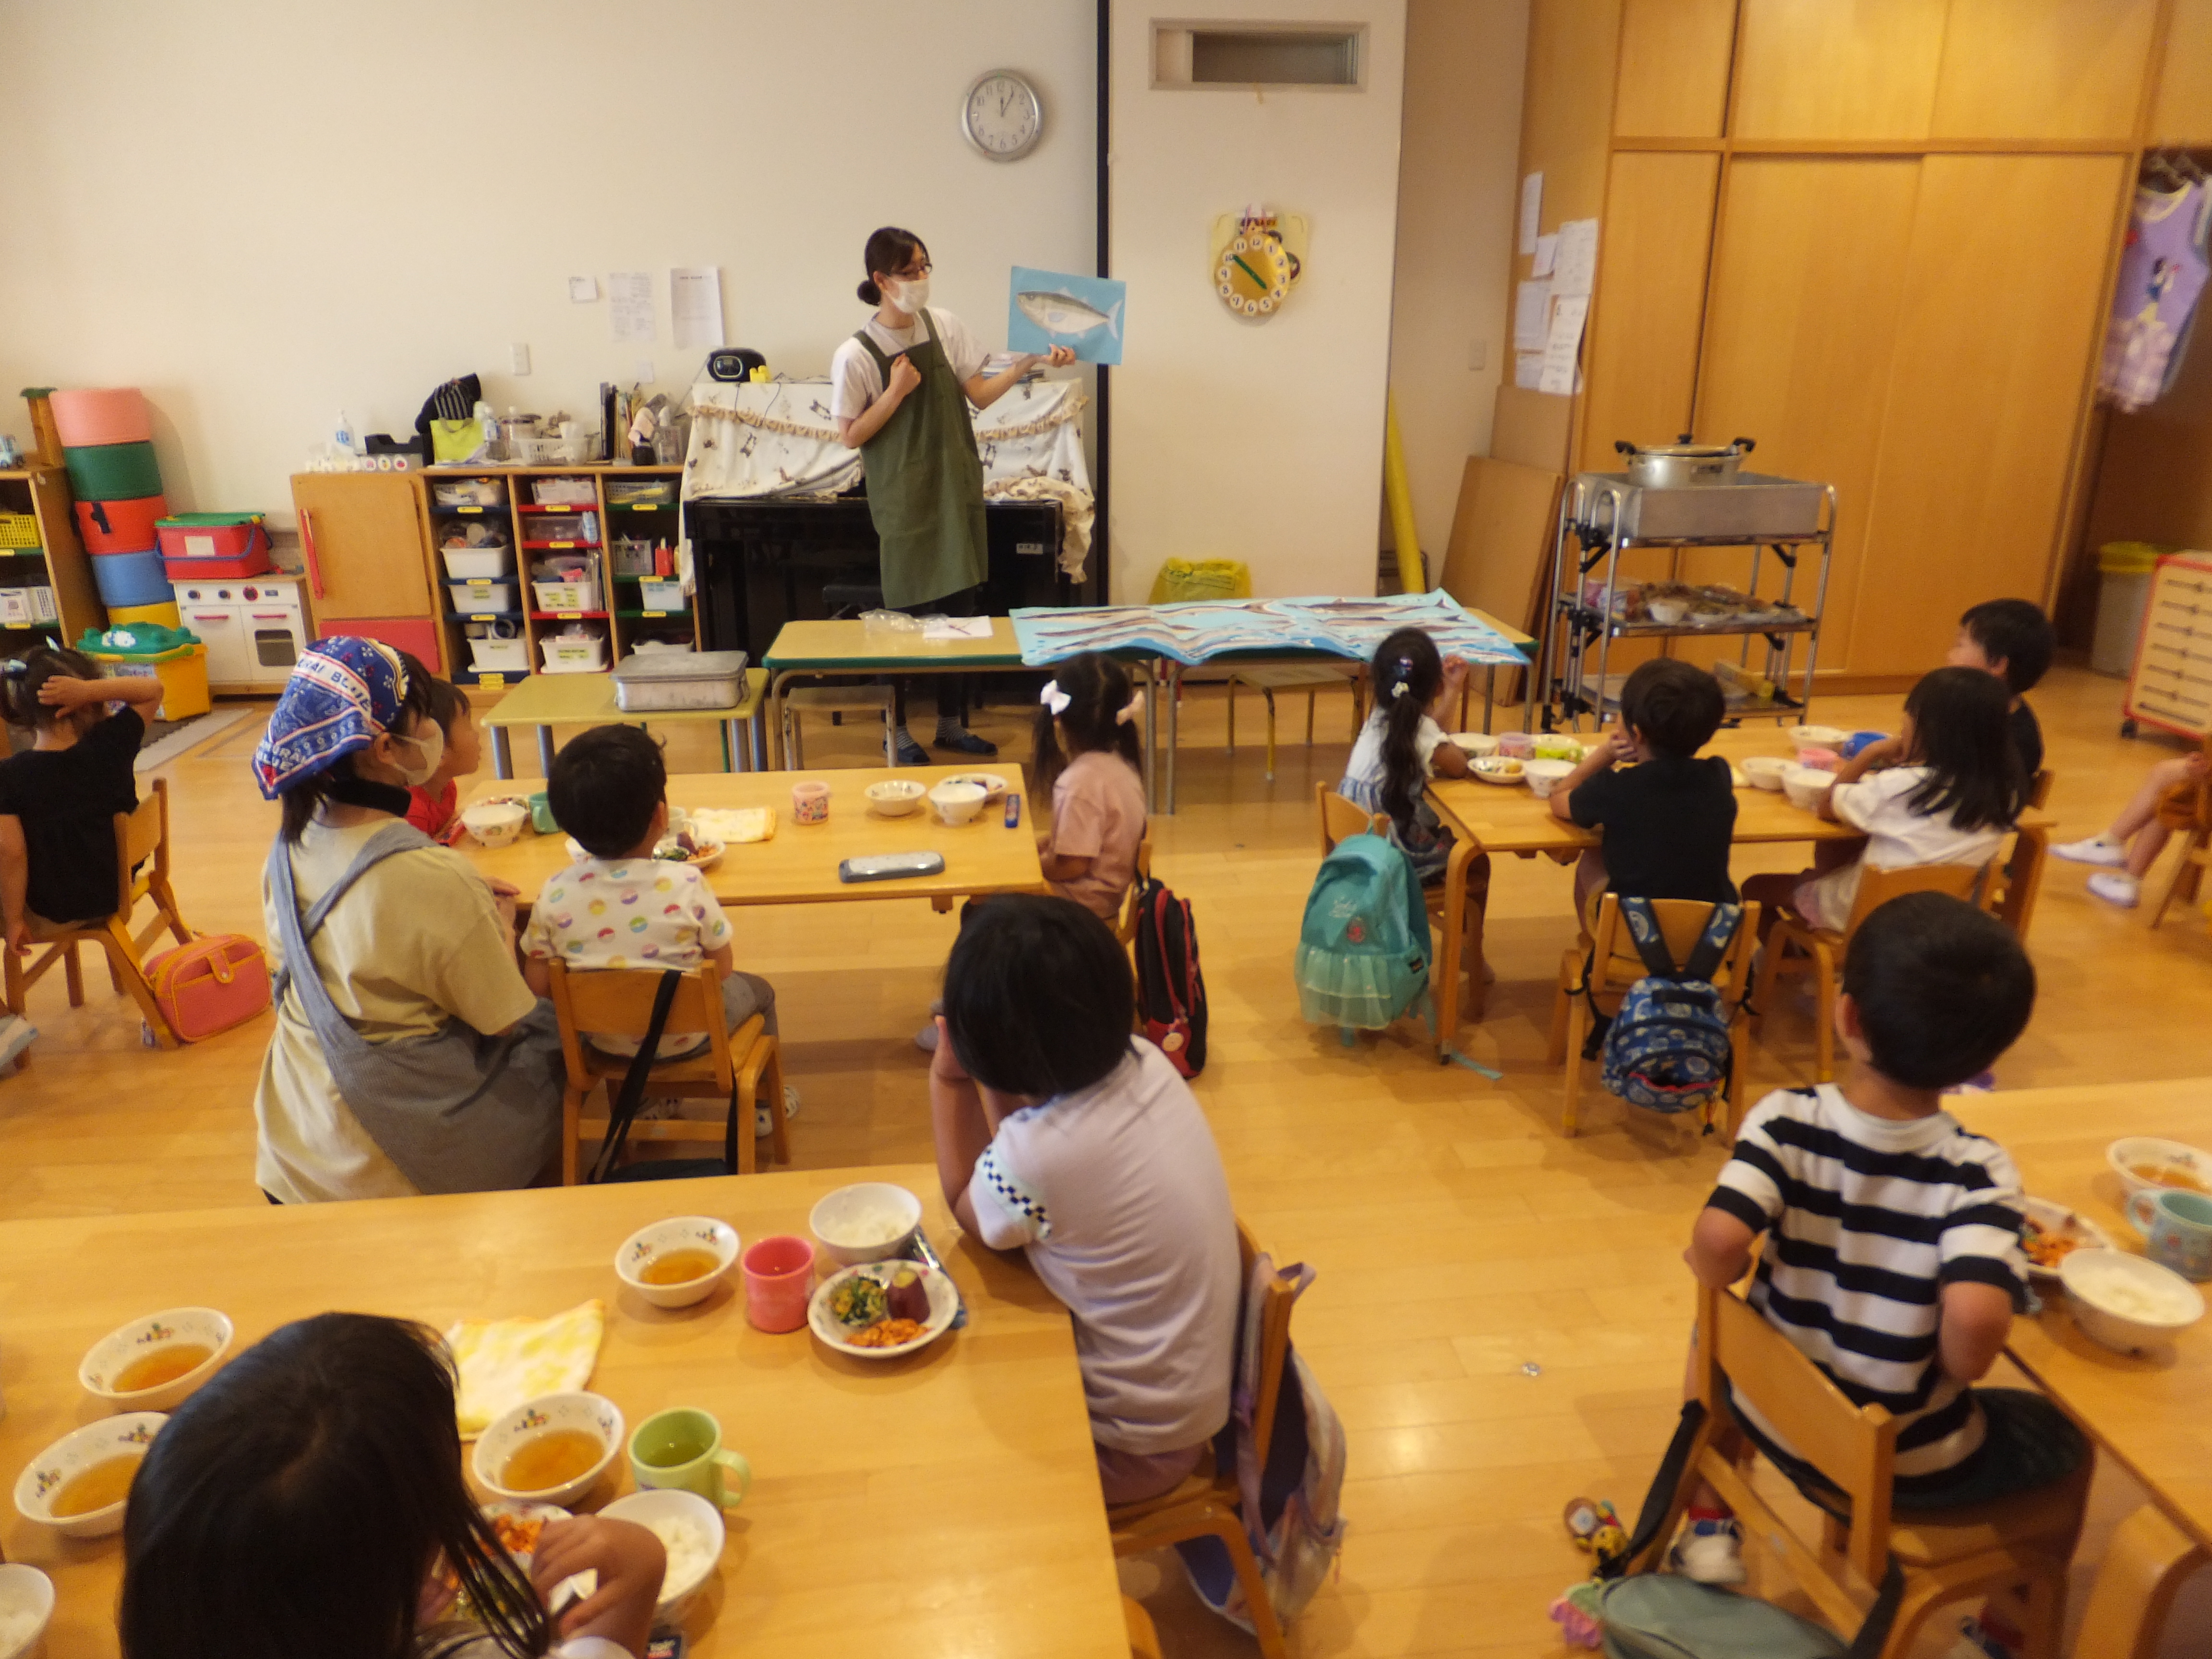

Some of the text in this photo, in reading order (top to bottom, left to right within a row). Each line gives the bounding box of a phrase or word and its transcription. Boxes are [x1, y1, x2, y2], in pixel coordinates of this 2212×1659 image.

[1221, 269, 1227, 278] 9
[1223, 285, 1229, 294] 8
[1275, 289, 1280, 298] 4
[1233, 297, 1240, 306] 7
[1263, 300, 1269, 309] 5
[1248, 303, 1254, 312] 6
